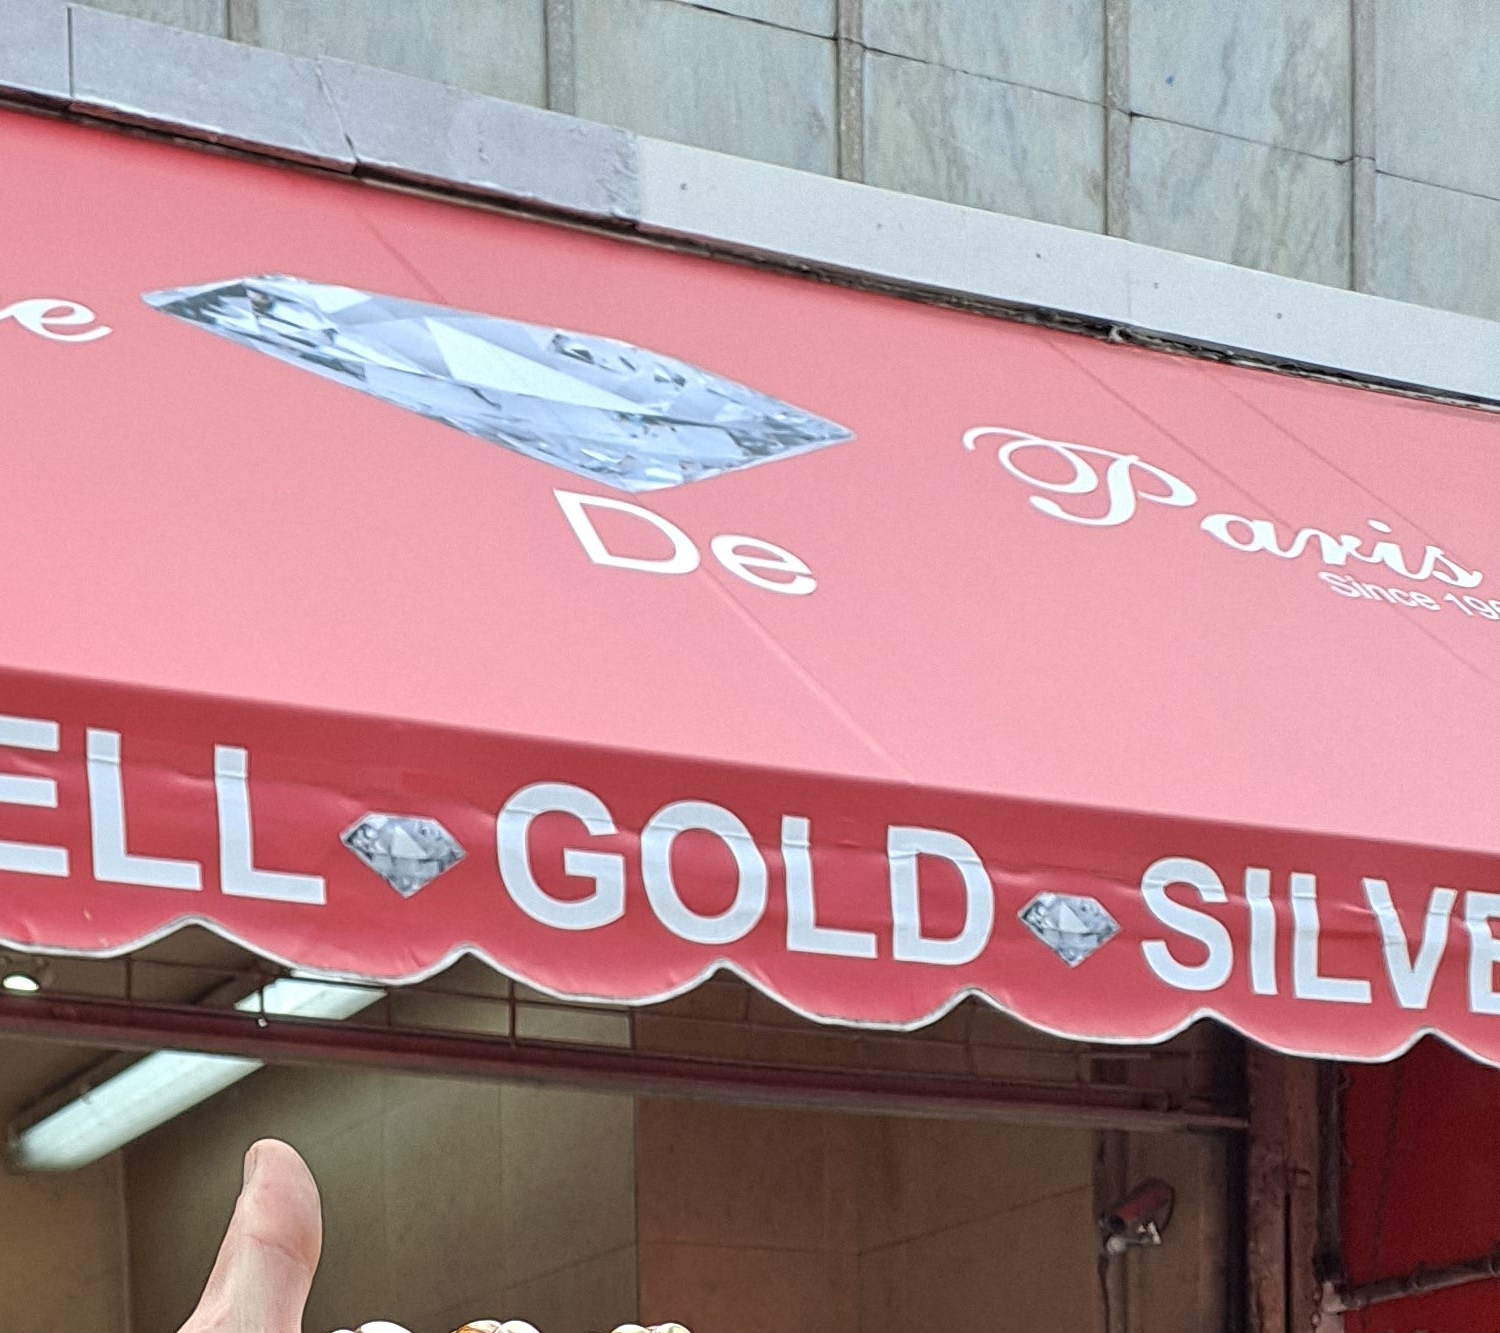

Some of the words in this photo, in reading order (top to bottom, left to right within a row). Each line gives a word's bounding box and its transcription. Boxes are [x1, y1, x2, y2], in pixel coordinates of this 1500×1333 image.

[553, 489, 817, 597] De
[962, 427, 1484, 588] Paris
[1316, 571, 1442, 611] Since
[1443, 592, 1500, 621] 19
[496, 781, 996, 967] GOLD
